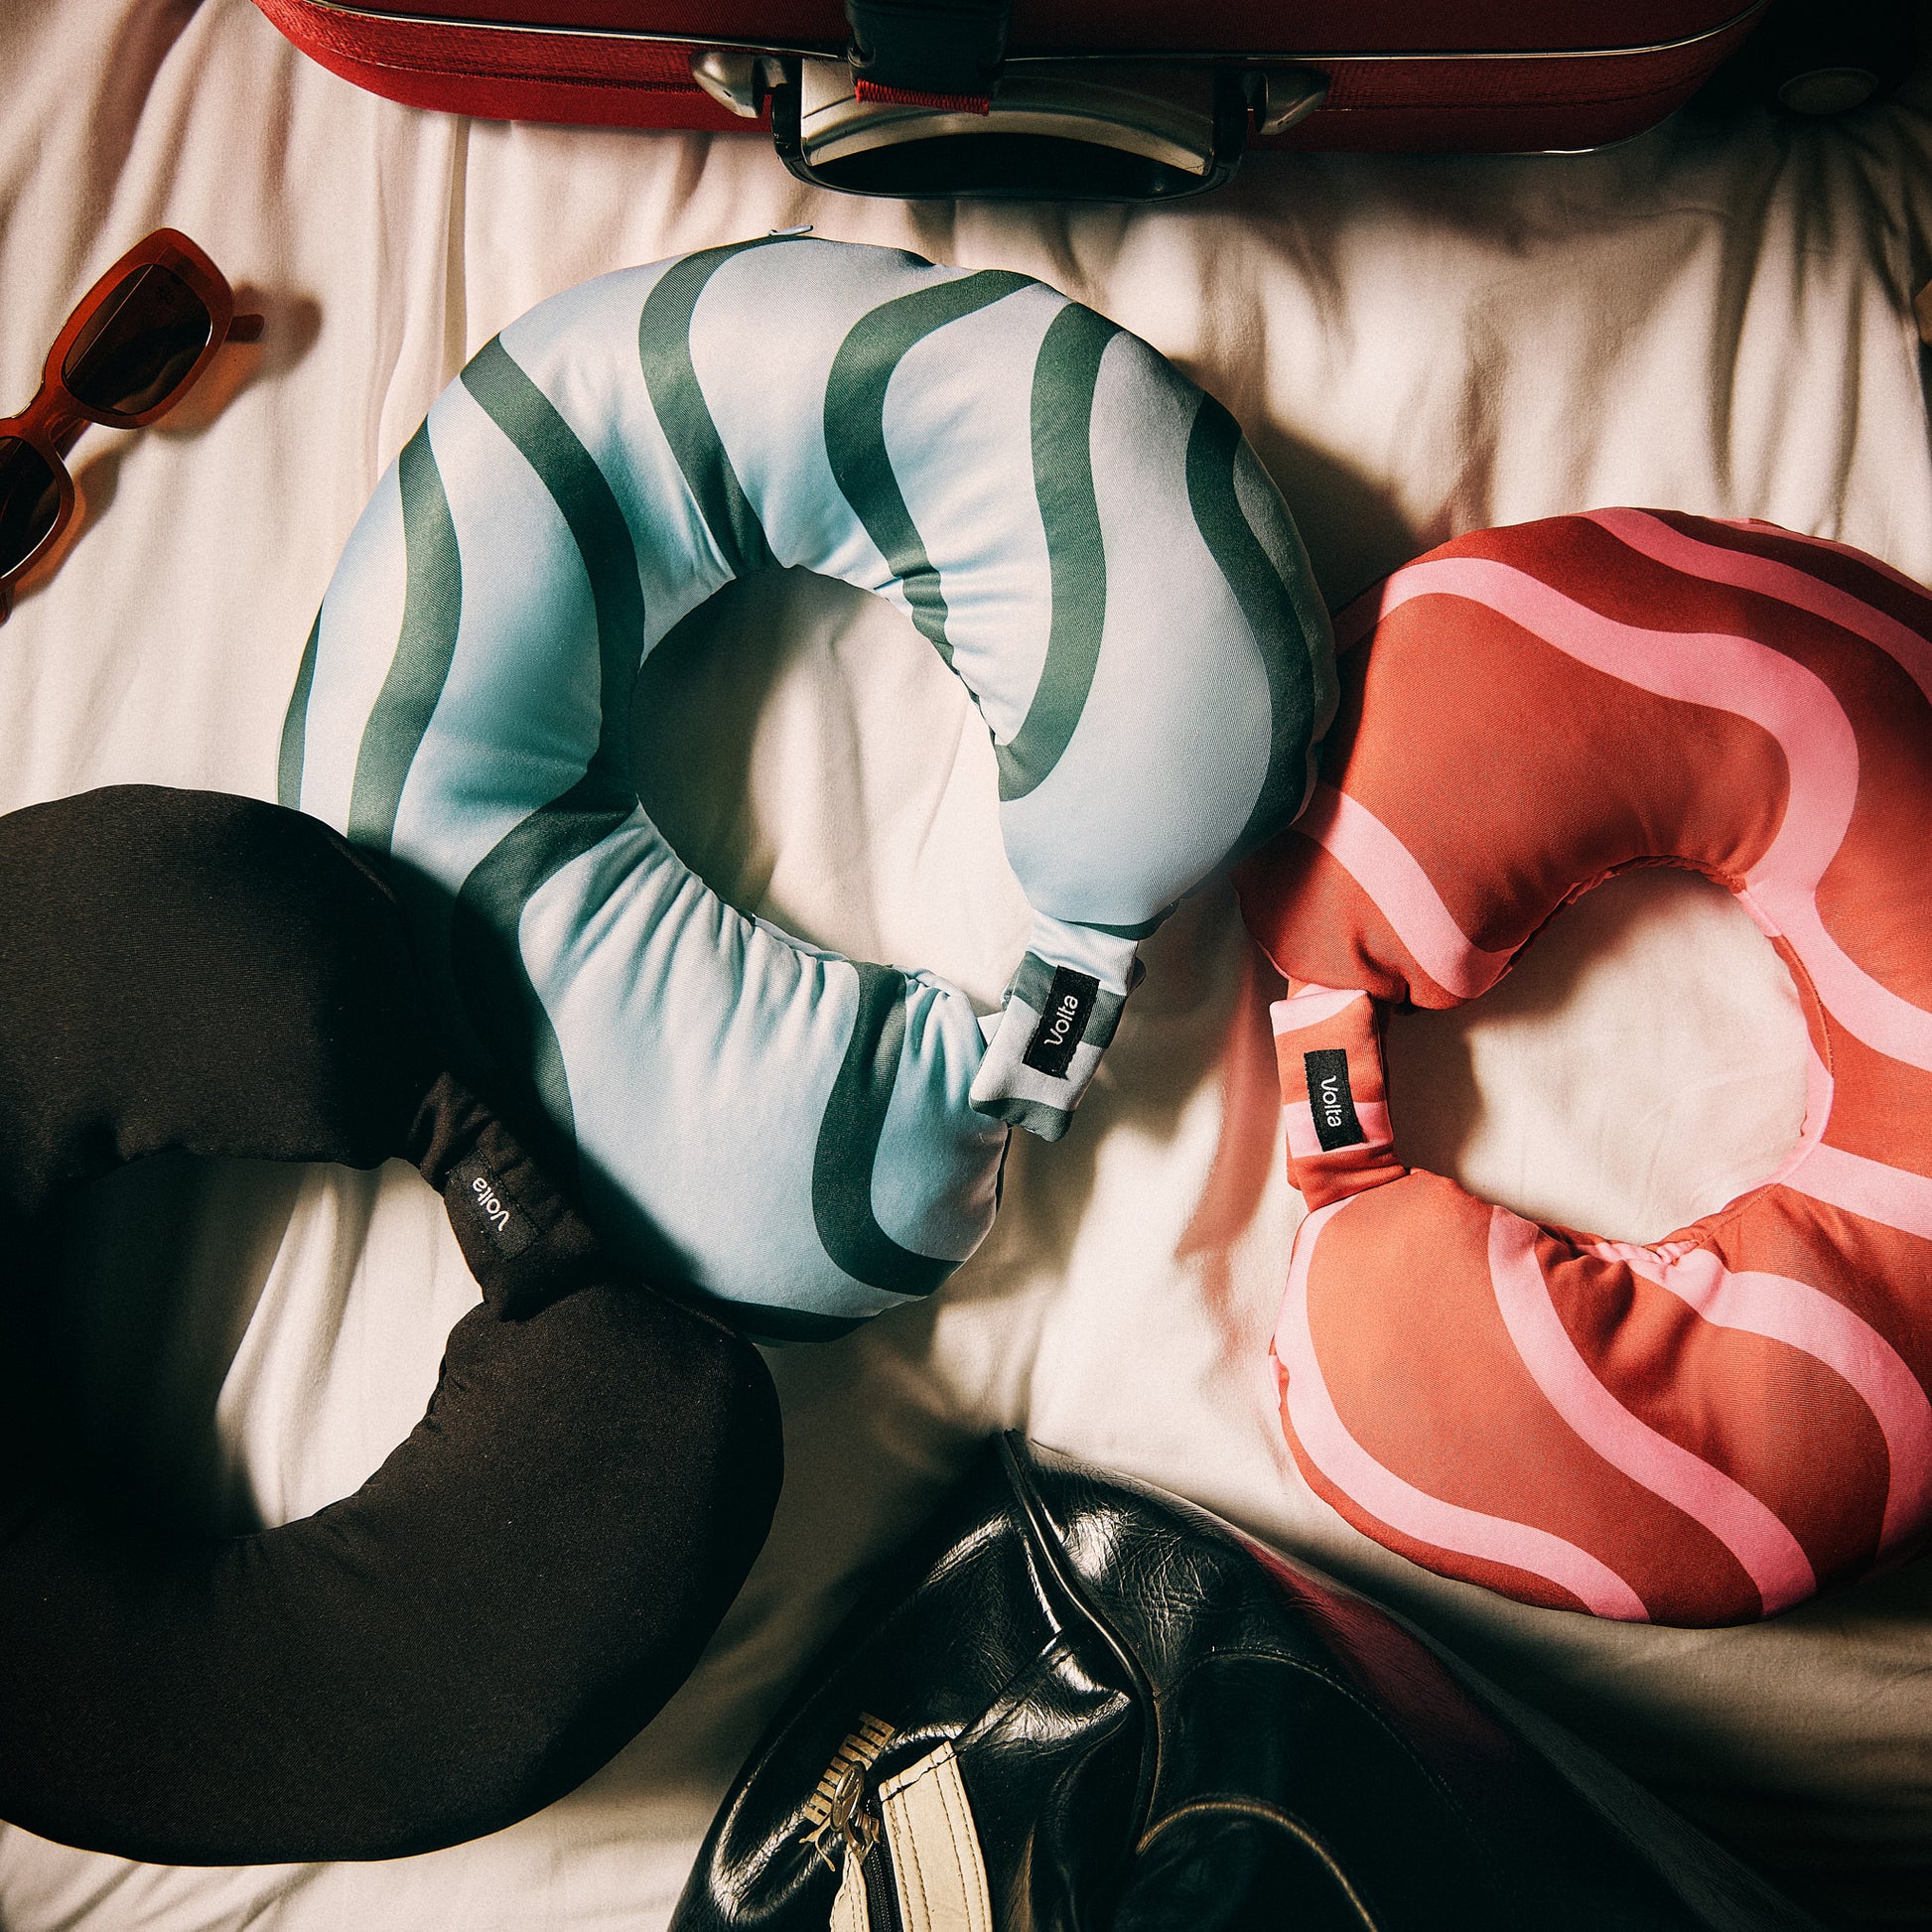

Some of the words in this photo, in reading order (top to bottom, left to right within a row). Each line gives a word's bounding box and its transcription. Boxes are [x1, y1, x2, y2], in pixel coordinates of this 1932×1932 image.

[1043, 995, 1078, 1045] Volta
[1320, 1074, 1342, 1128] Volta
[472, 1176, 510, 1232] Volta
